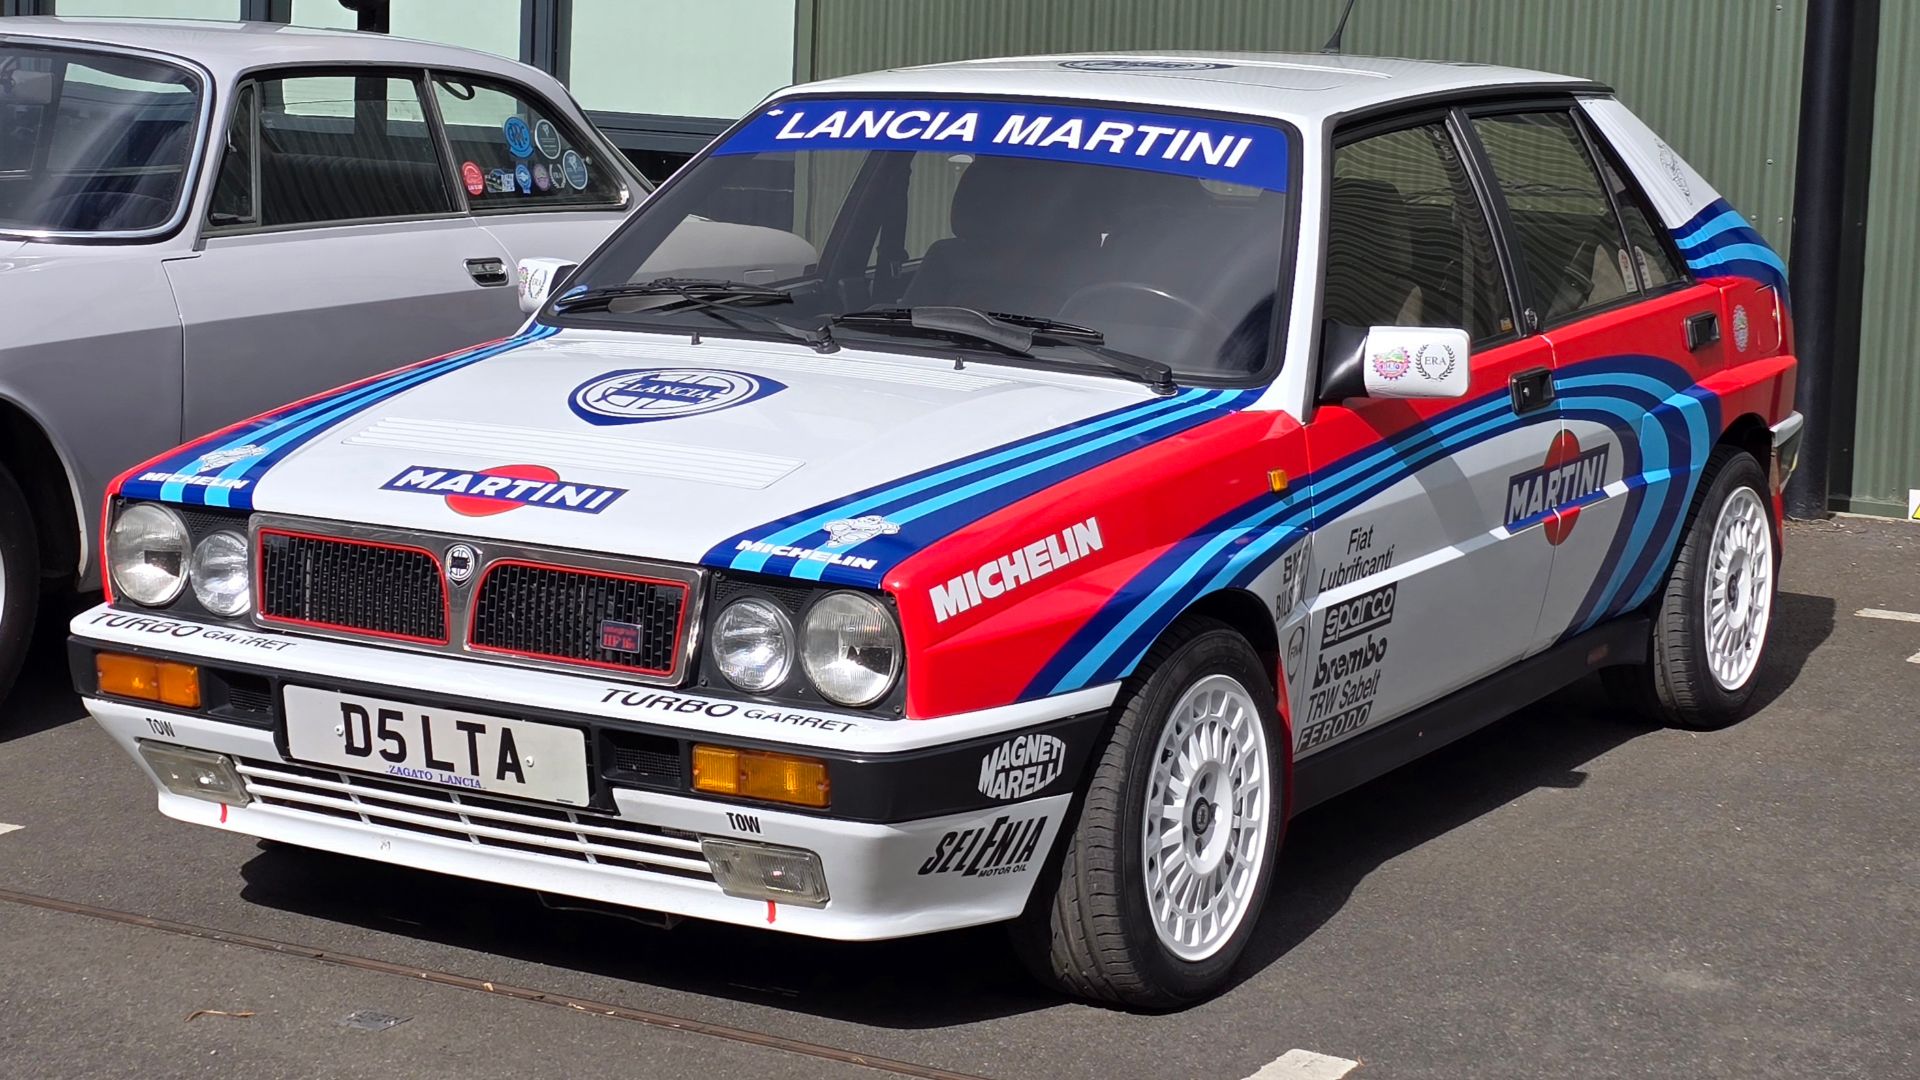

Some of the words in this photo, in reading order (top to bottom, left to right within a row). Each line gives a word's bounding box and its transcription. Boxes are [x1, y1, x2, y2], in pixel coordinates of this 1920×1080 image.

[775, 109, 979, 143] LANCIA
[992, 113, 1253, 168] MARTINI
[1424, 356, 1447, 366] ERA
[624, 383, 712, 398] LANCIA
[138, 472, 250, 489] MICHELIN
[393, 469, 614, 509] MARTINI
[1507, 453, 1605, 525] MARTINI
[735, 539, 878, 570] MICHELIN
[1347, 524, 1374, 555] Fiat
[928, 517, 1103, 623] MICHELIN
[1318, 544, 1395, 593] Lubrificanti
[89, 612, 204, 637] TURBO
[202, 630, 297, 652] GARRET
[1325, 587, 1394, 641] sparco
[1312, 634, 1388, 690] brembo
[600, 687, 739, 717] TURBO
[743, 708, 858, 733] GARRET
[1306, 682, 1340, 724] TRW
[1339, 669, 1381, 711] Sabelt
[146, 718, 175, 737] TOW
[340, 701, 408, 763] D5
[420, 714, 526, 784] LTA
[1297, 703, 1370, 748] FERODO
[388, 764, 433, 781] ZAGATO
[439, 773, 482, 789] LANCIA
[979, 734, 1066, 778] MAGNETI
[726, 812, 761, 834] TOW
[917, 815, 1048, 877] SELENIA
[978, 866, 1011, 877] MOTOR
[1012, 863, 1027, 873] OIL
